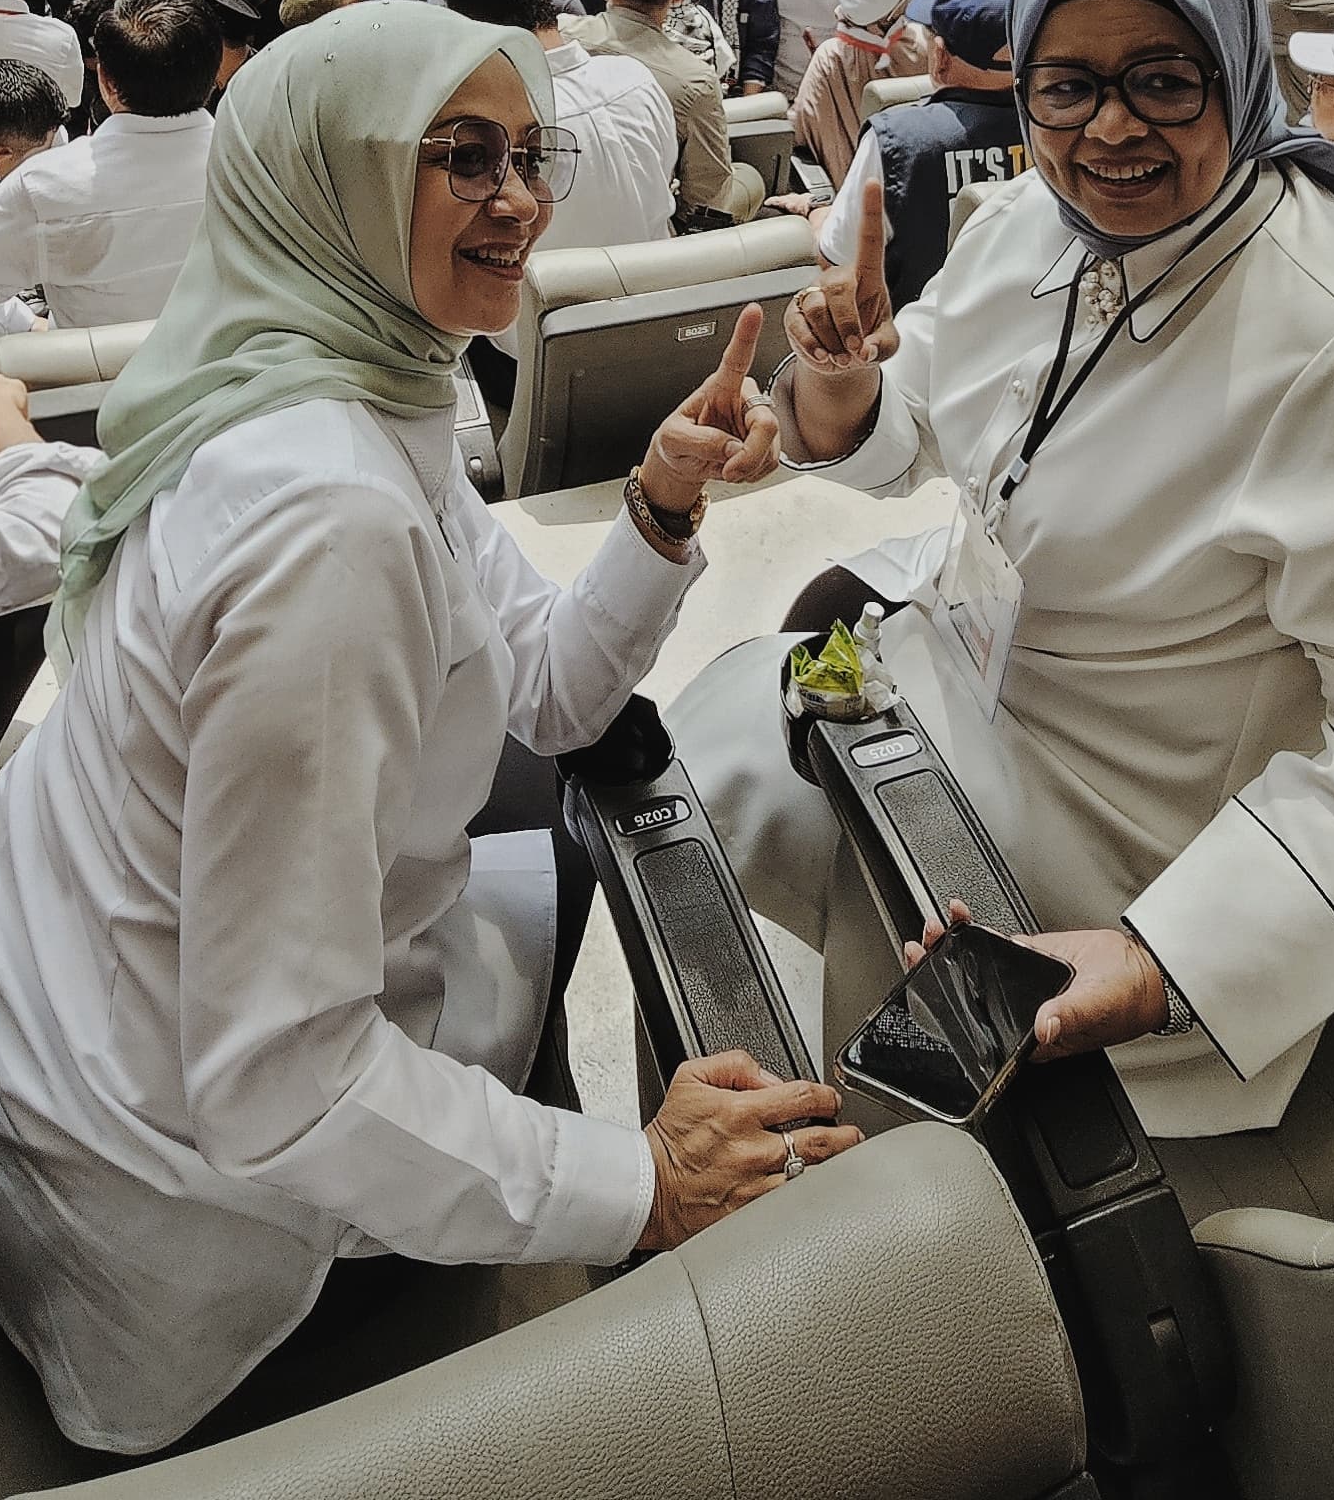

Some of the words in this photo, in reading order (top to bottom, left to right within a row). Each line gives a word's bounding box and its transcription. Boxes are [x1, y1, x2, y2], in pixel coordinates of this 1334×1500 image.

[945, 146, 1005, 194] IT'S
[869, 741, 904, 759] C025
[634, 807, 672, 827] C026
